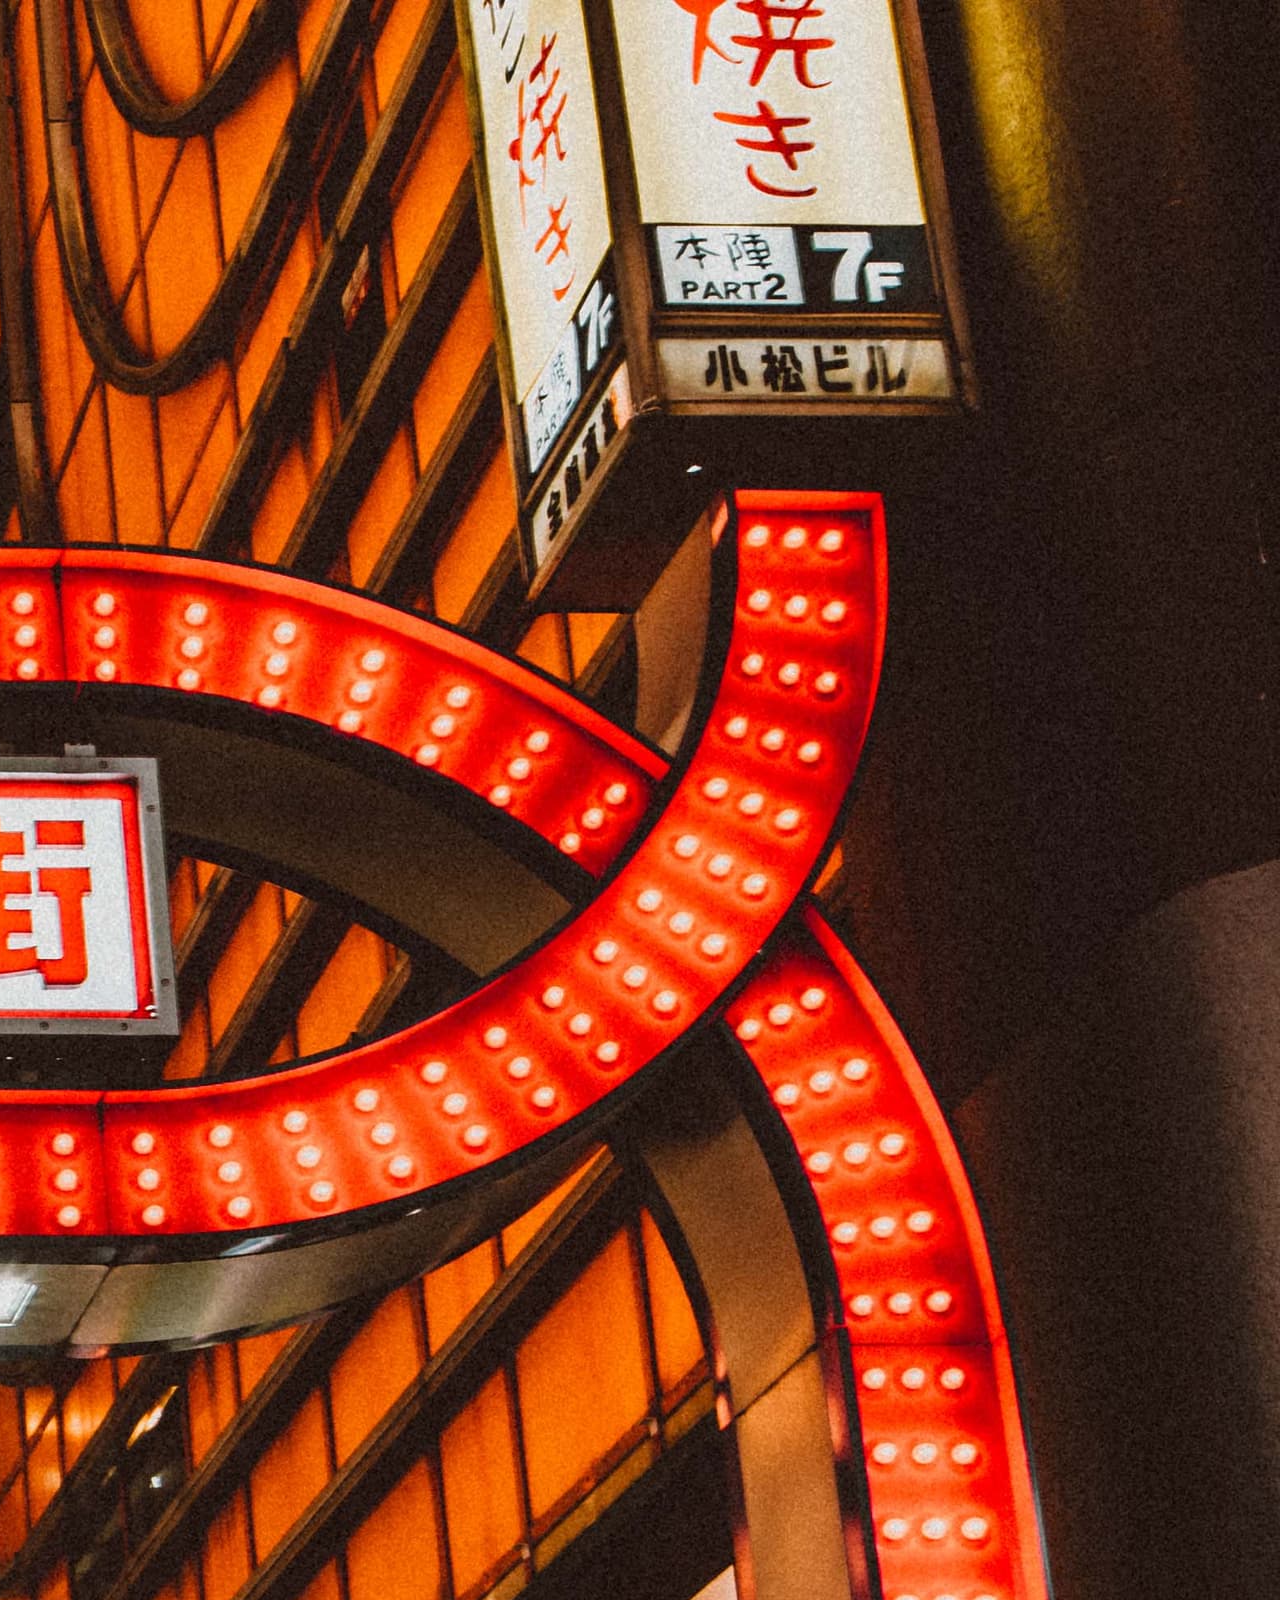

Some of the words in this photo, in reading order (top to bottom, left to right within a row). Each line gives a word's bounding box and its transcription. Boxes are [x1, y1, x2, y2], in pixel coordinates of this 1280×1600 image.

[675, 232, 771, 271] 本陣
[811, 230, 905, 303] 7F
[681, 272, 788, 301] PART2
[704, 345, 907, 393] 小松ビル
